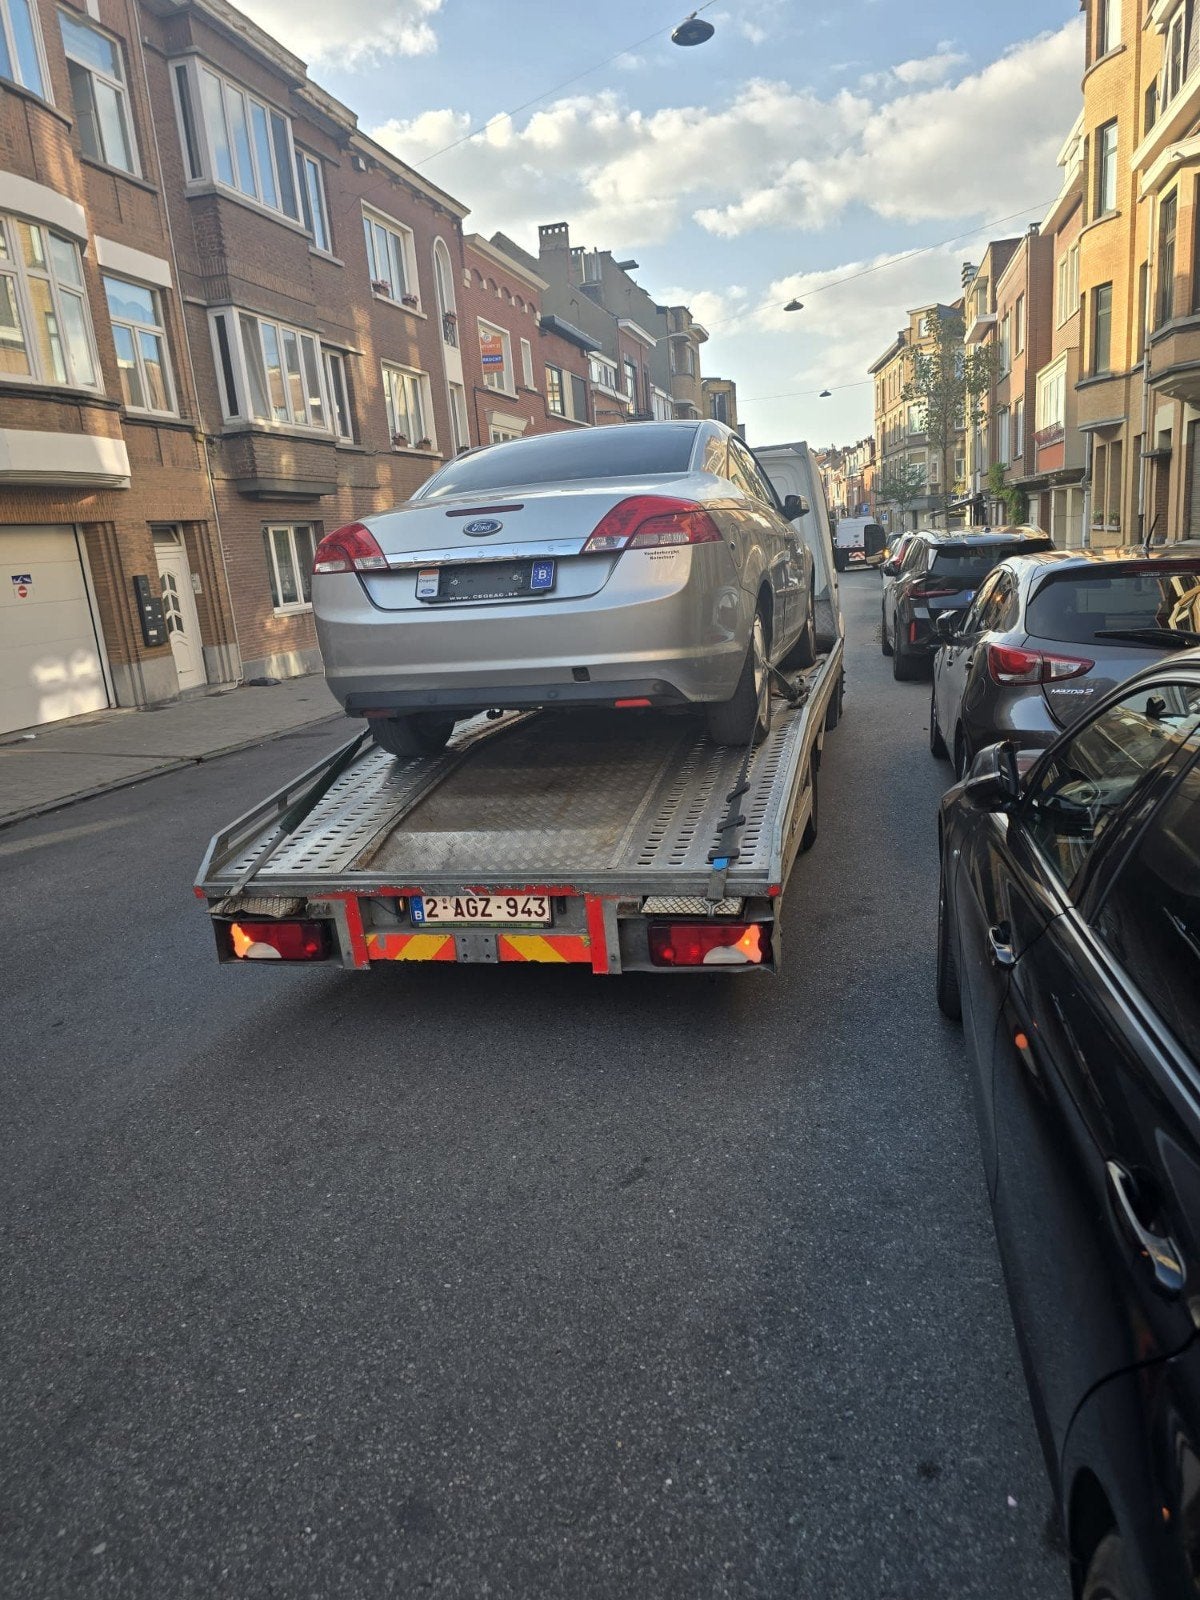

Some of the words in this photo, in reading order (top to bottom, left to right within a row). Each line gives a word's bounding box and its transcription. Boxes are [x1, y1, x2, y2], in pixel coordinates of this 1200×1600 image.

[538, 569, 547, 580] B
[425, 897, 546, 918] 2-AGZ-943
[414, 910, 423, 920] B
